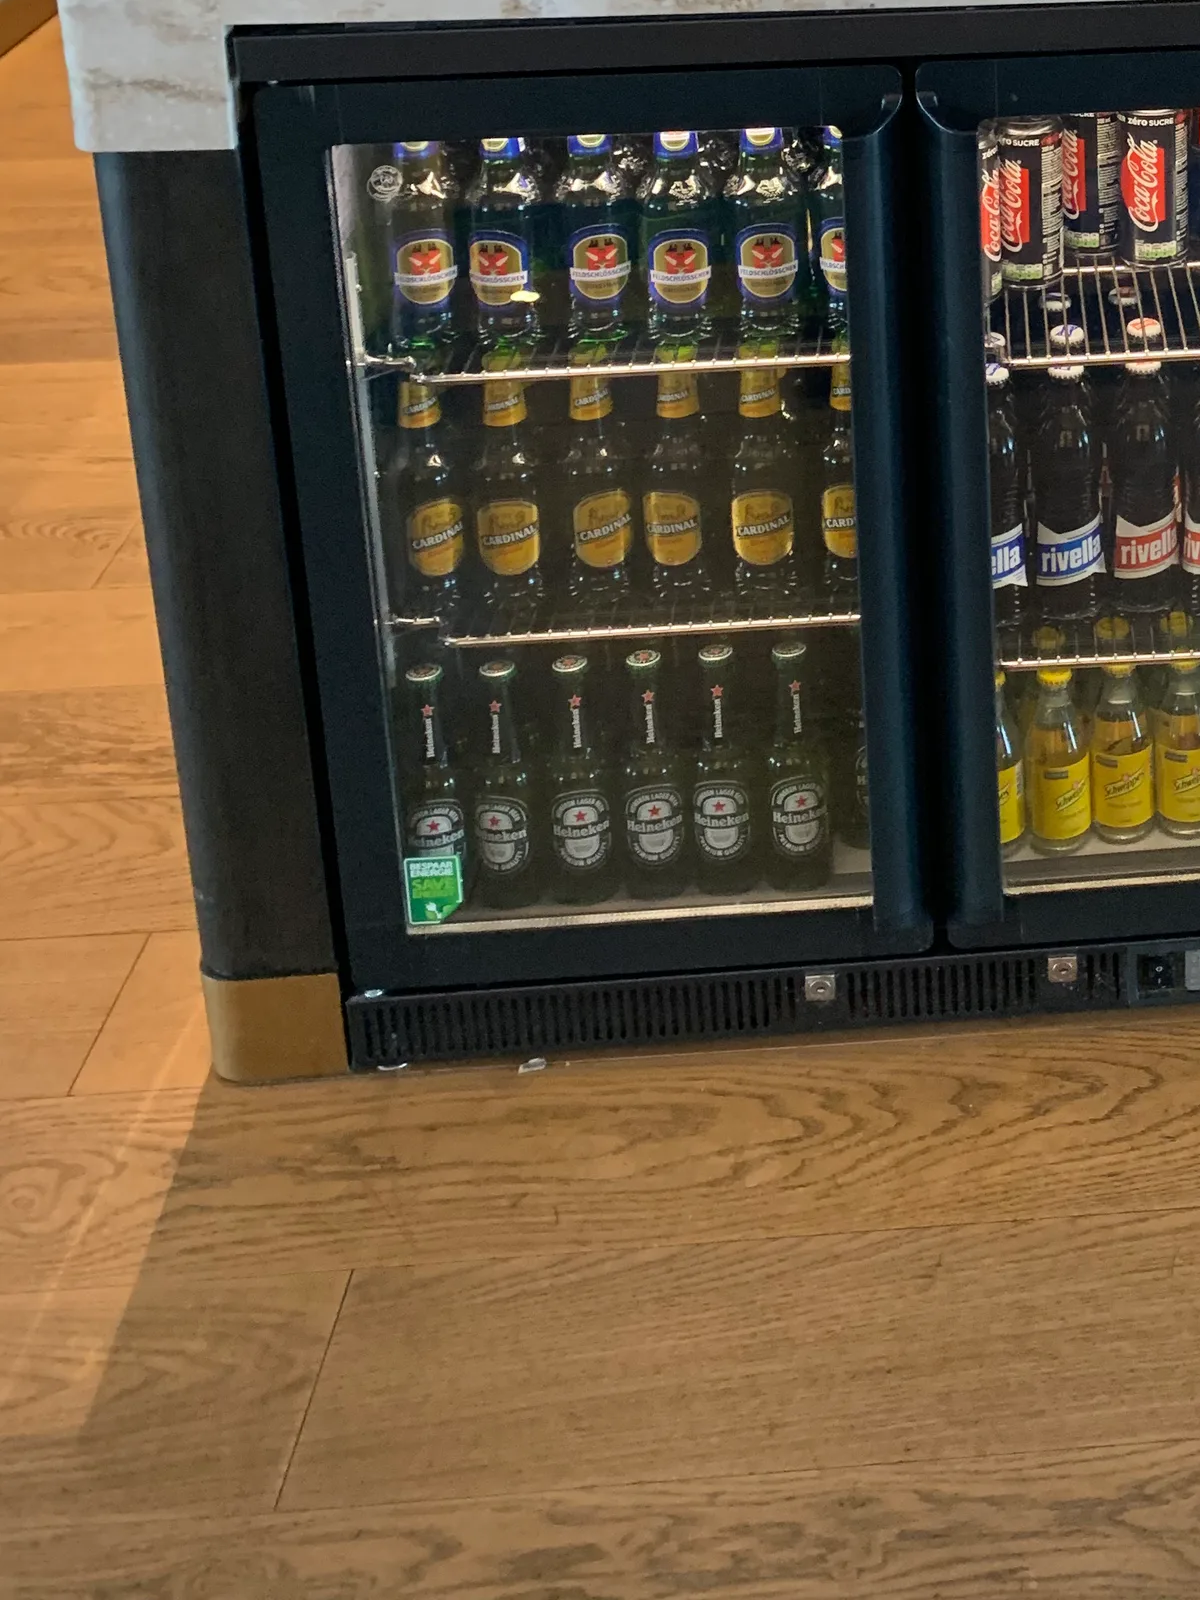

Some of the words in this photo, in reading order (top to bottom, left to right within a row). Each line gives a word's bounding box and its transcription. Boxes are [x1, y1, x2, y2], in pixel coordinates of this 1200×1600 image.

[1149, 116, 1174, 127] SUCRE
[1013, 138, 1040, 147] SUCRE
[412, 521, 463, 549] CARDINAL
[483, 525, 537, 545] CARDINAL
[580, 513, 631, 541] CARDINAL
[648, 519, 697, 534] CARDINAL
[738, 515, 790, 536] CARDINAL
[1041, 534, 1101, 573] rivella
[1121, 526, 1177, 565] rivella
[991, 545, 1021, 575] ella
[553, 820, 609, 838] Heineken
[627, 814, 682, 832] Heineken
[694, 812, 749, 827] Heineken
[481, 830, 527, 842] ineken
